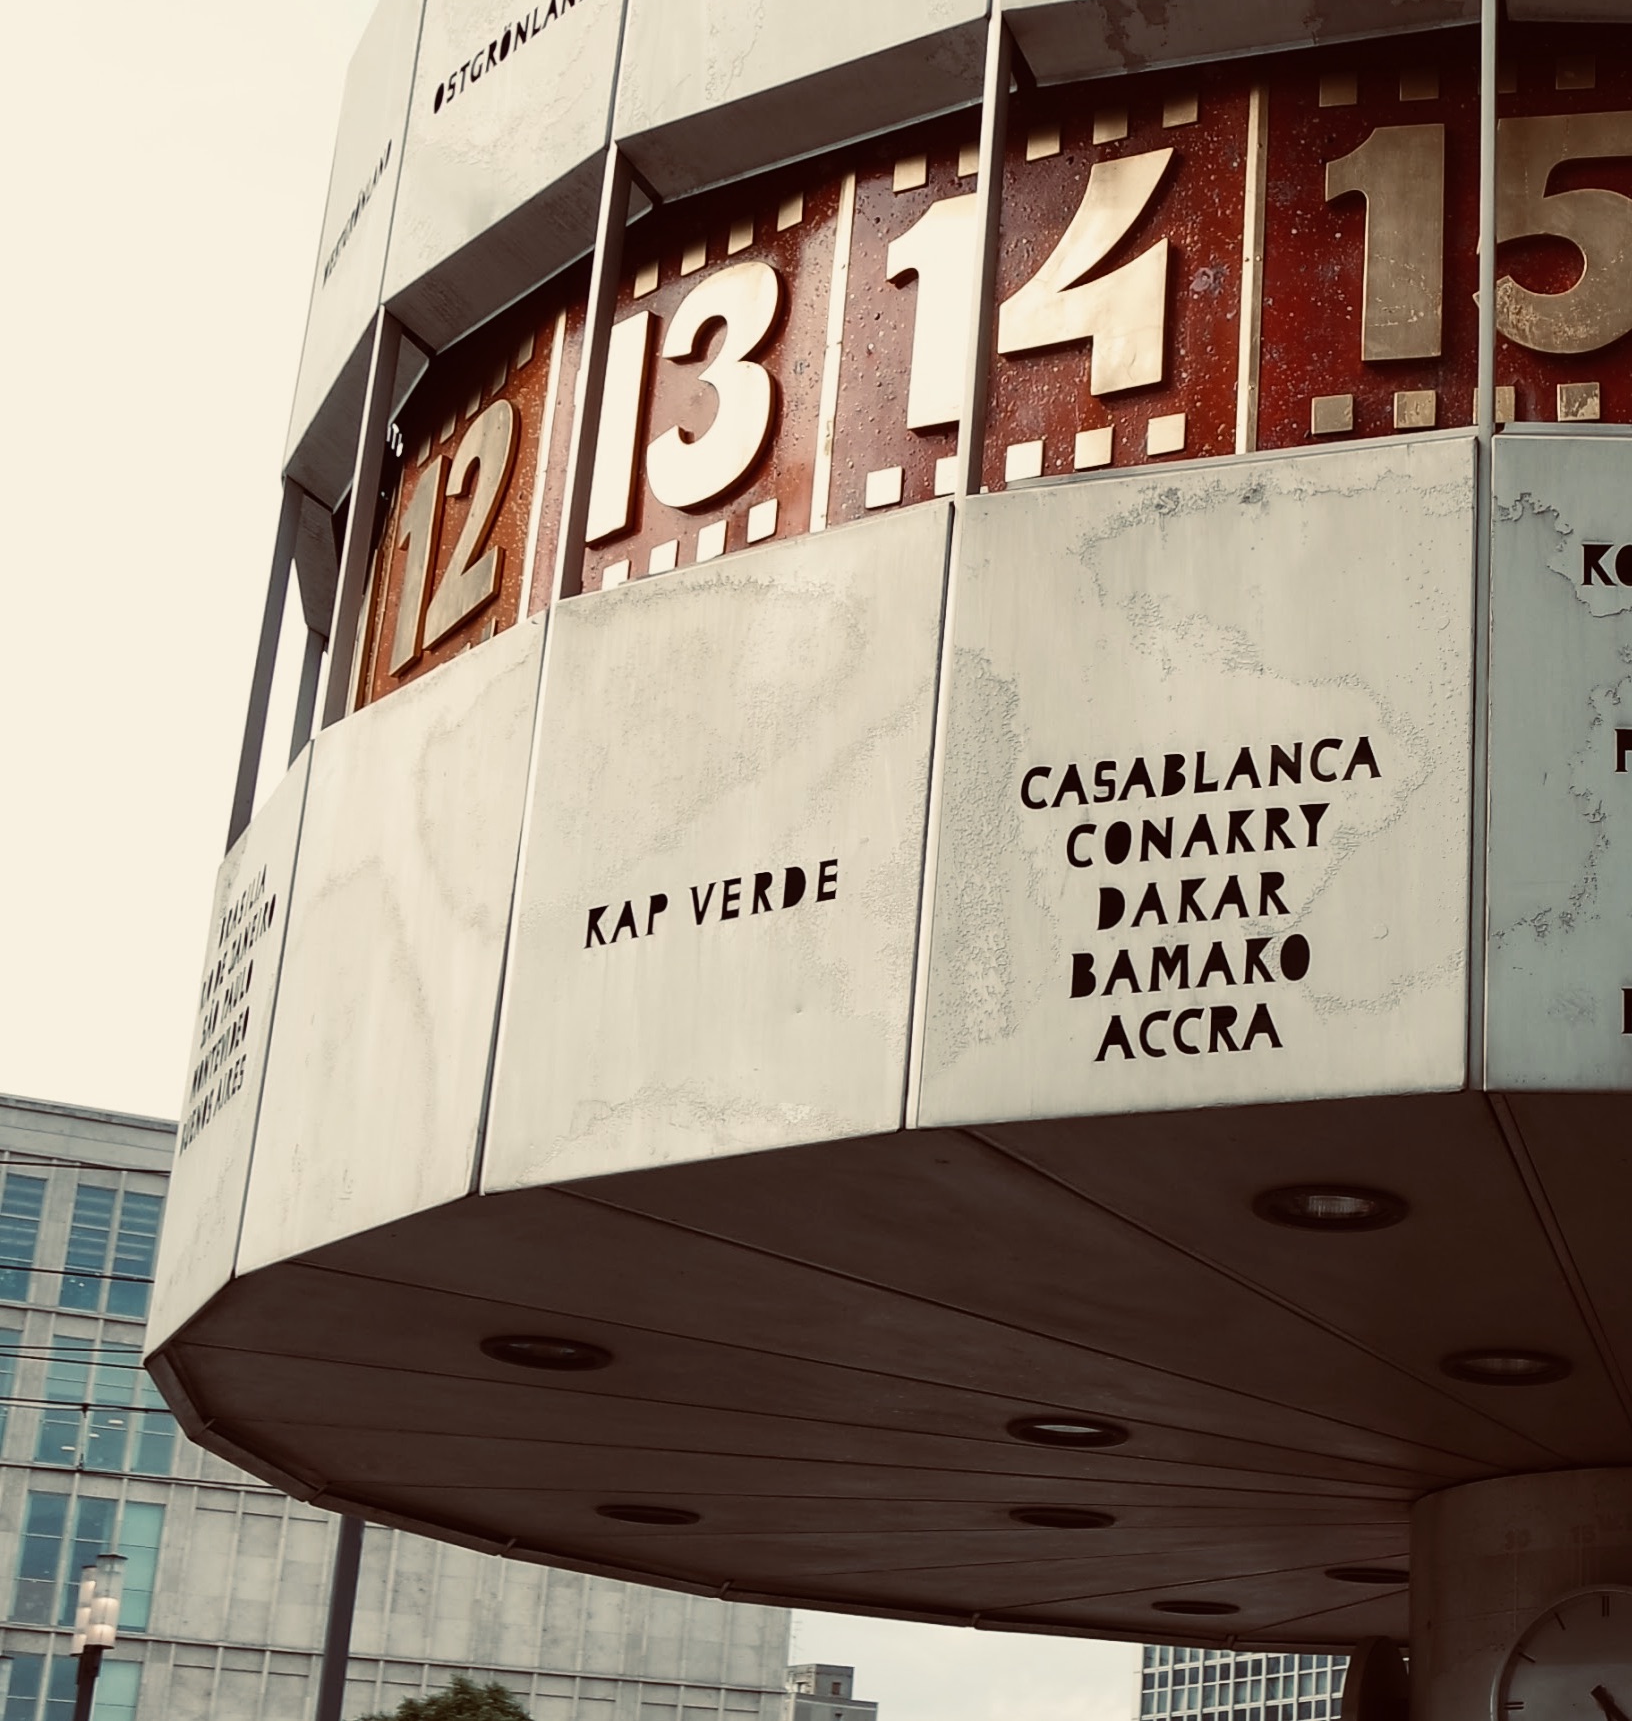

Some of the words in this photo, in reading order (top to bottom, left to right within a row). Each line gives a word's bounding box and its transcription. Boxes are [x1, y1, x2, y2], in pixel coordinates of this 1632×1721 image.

[886, 147, 1174, 433] 14
[585, 261, 783, 549] 13
[389, 397, 519, 678] 12
[1020, 736, 1382, 810] CASABLANCA
[1066, 802, 1330, 868] CONAKRY
[585, 893, 668, 949] KAP
[690, 858, 838, 925] VERDE
[1097, 871, 1291, 931] DAKAR
[1069, 933, 1310, 999] BAMAKO
[1094, 1003, 1283, 1062] ACCRA
